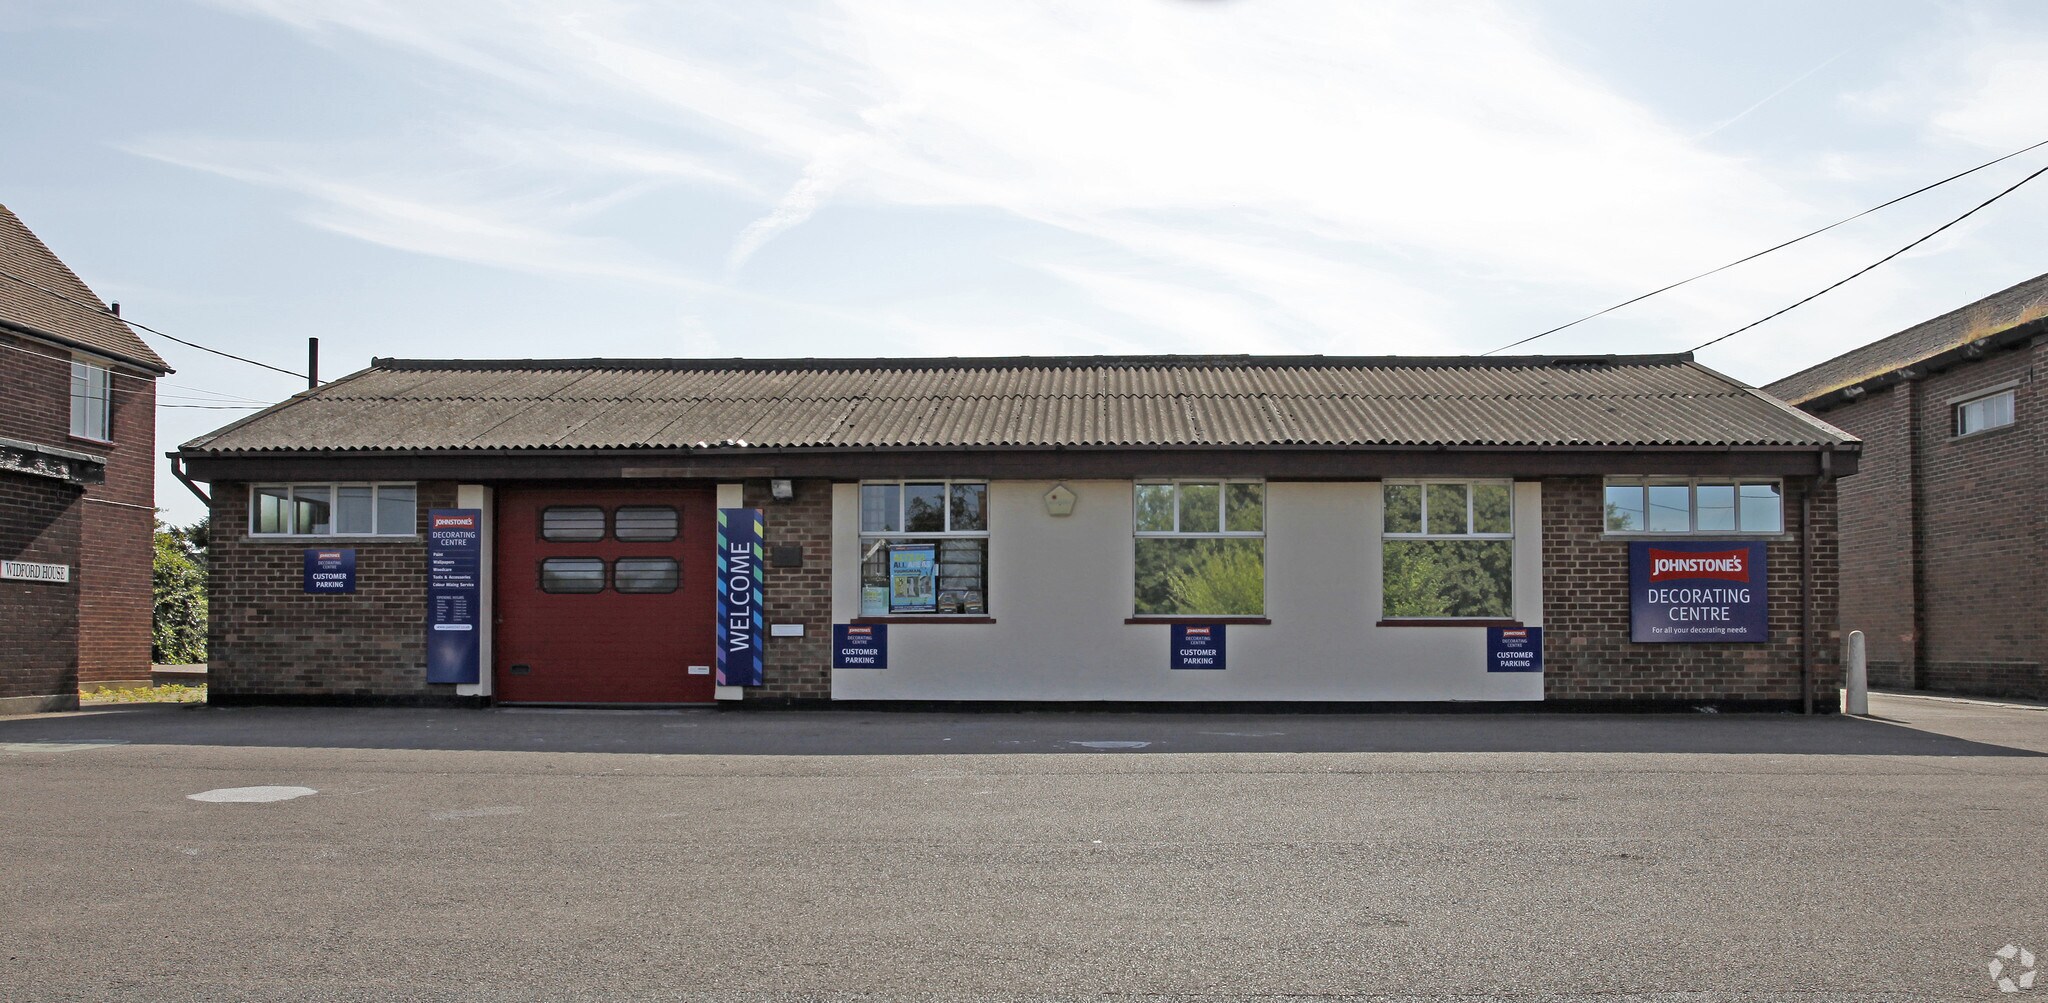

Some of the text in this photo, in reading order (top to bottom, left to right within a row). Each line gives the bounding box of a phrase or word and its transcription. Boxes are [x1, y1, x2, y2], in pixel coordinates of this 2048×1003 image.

[435, 517, 473, 527] JOHNSTONE'S
[432, 531, 476, 539] DECORATING
[440, 538, 467, 546] CENTRE
[5, 562, 65, 580] WIDFORD HOUSE
[1652, 555, 1742, 576] JOHNSTONE'S
[730, 542, 750, 652] WELCOME
[1648, 588, 1751, 604] DECORATING
[1669, 606, 1731, 621] CENTRE
[1652, 626, 1663, 634] For
[1664, 626, 1673, 634] all
[1690, 626, 1726, 635] decorating
[1727, 626, 1748, 634] needs
[1496, 651, 1534, 659] CUSTOMER
